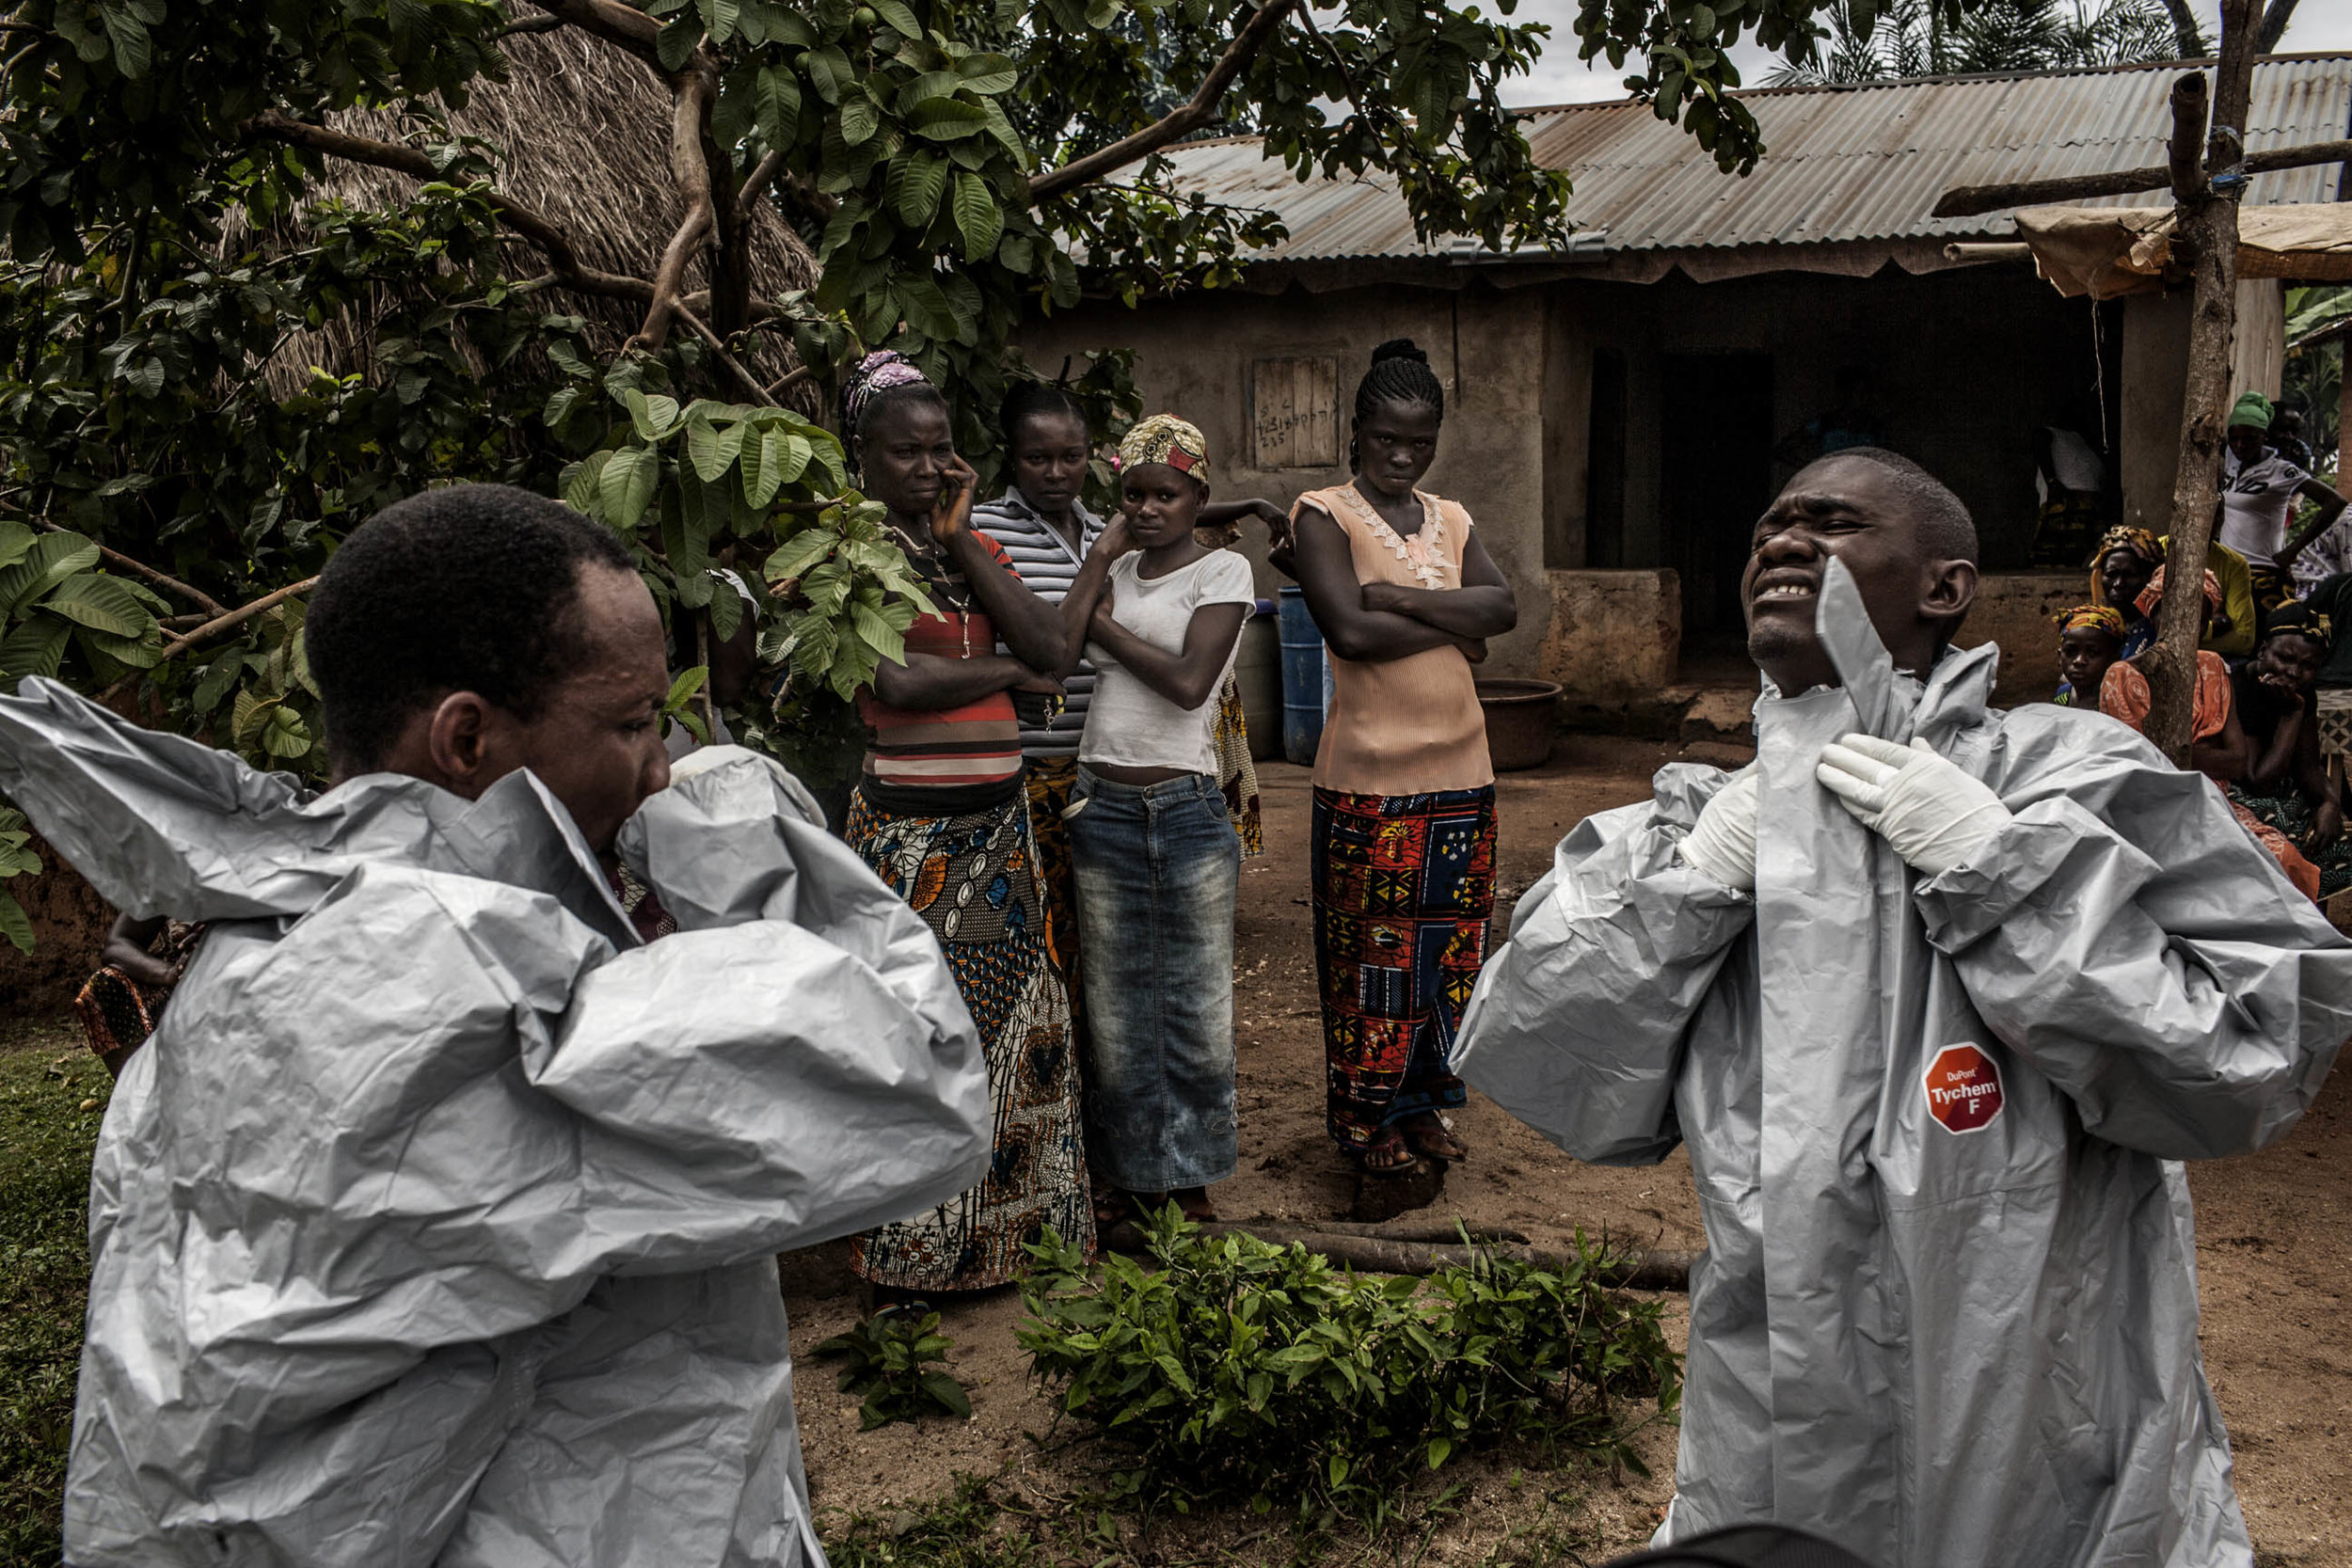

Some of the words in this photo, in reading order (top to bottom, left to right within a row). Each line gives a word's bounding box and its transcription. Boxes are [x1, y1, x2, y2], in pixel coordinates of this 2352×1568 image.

[1947, 1069, 1977, 1082] DuPont
[1931, 1082, 1996, 1105] Tychem
[1968, 1099, 1980, 1115] F
